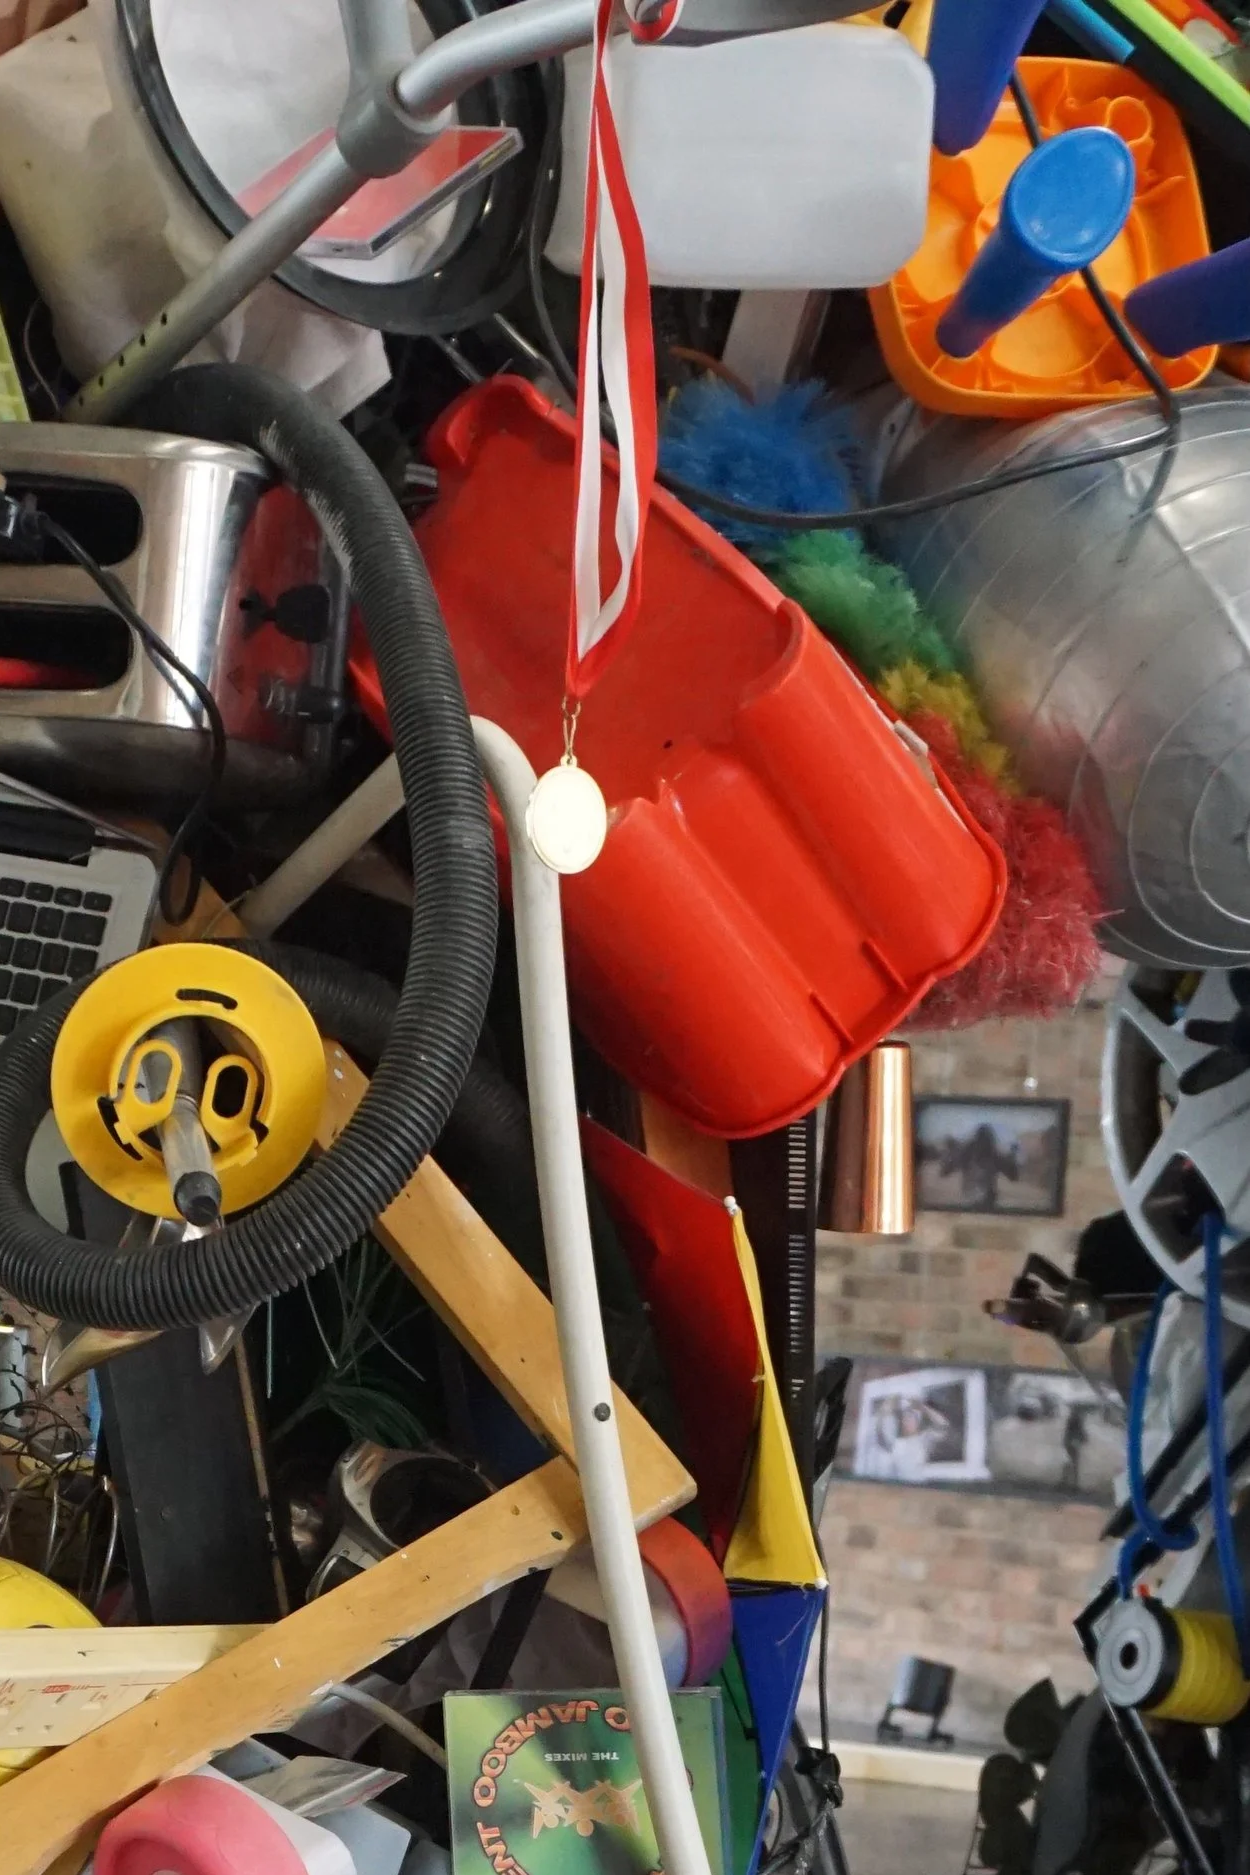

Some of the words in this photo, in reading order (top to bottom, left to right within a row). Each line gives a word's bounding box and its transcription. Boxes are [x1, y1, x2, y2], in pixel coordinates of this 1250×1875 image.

[472, 1699, 599, 1808] JAMBOO
[544, 1752, 588, 1762] MIXES
[592, 1752, 619, 1761] THE
